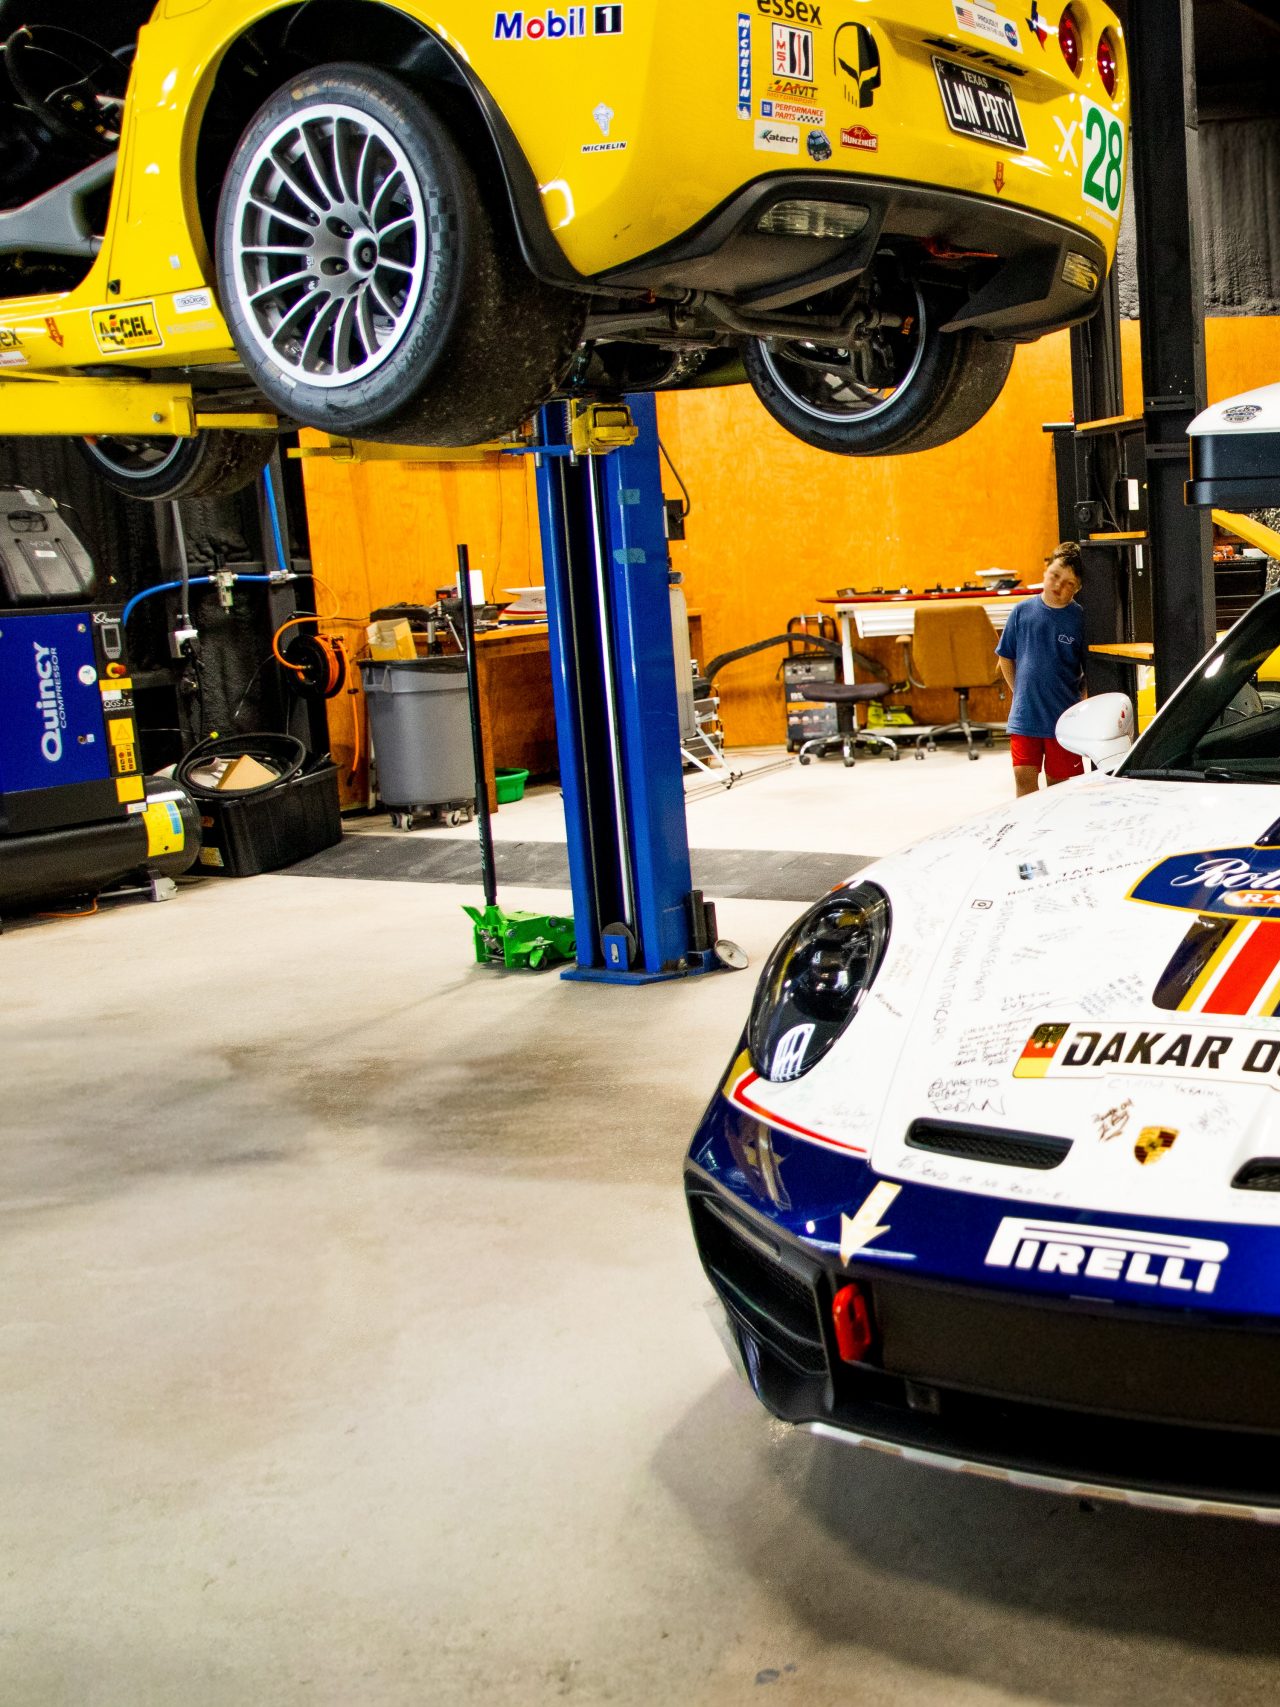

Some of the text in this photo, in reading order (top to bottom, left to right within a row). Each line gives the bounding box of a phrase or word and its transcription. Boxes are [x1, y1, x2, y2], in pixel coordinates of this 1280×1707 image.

[494, 7, 585, 39] Mobil
[757, 0, 822, 25] essex
[739, 18, 750, 98] MICHELIN
[776, 29, 786, 72] IMSA
[961, 70, 989, 89] TEXAS
[775, 103, 824, 117] PERFORMANCE
[775, 111, 796, 121] PARTS
[944, 79, 1018, 138] LMN PRTY
[582, 142, 627, 152] MICHELIN
[761, 129, 798, 143] Katech
[1083, 107, 1122, 211] 28
[34, 641, 64, 762] Quincy
[50, 647, 67, 729] COMPRESSOR
[104, 699, 134, 709] QGS-7.5
[1061, 1030, 1234, 1070] DAKAR
[985, 1217, 1229, 1294] PIRELLI
